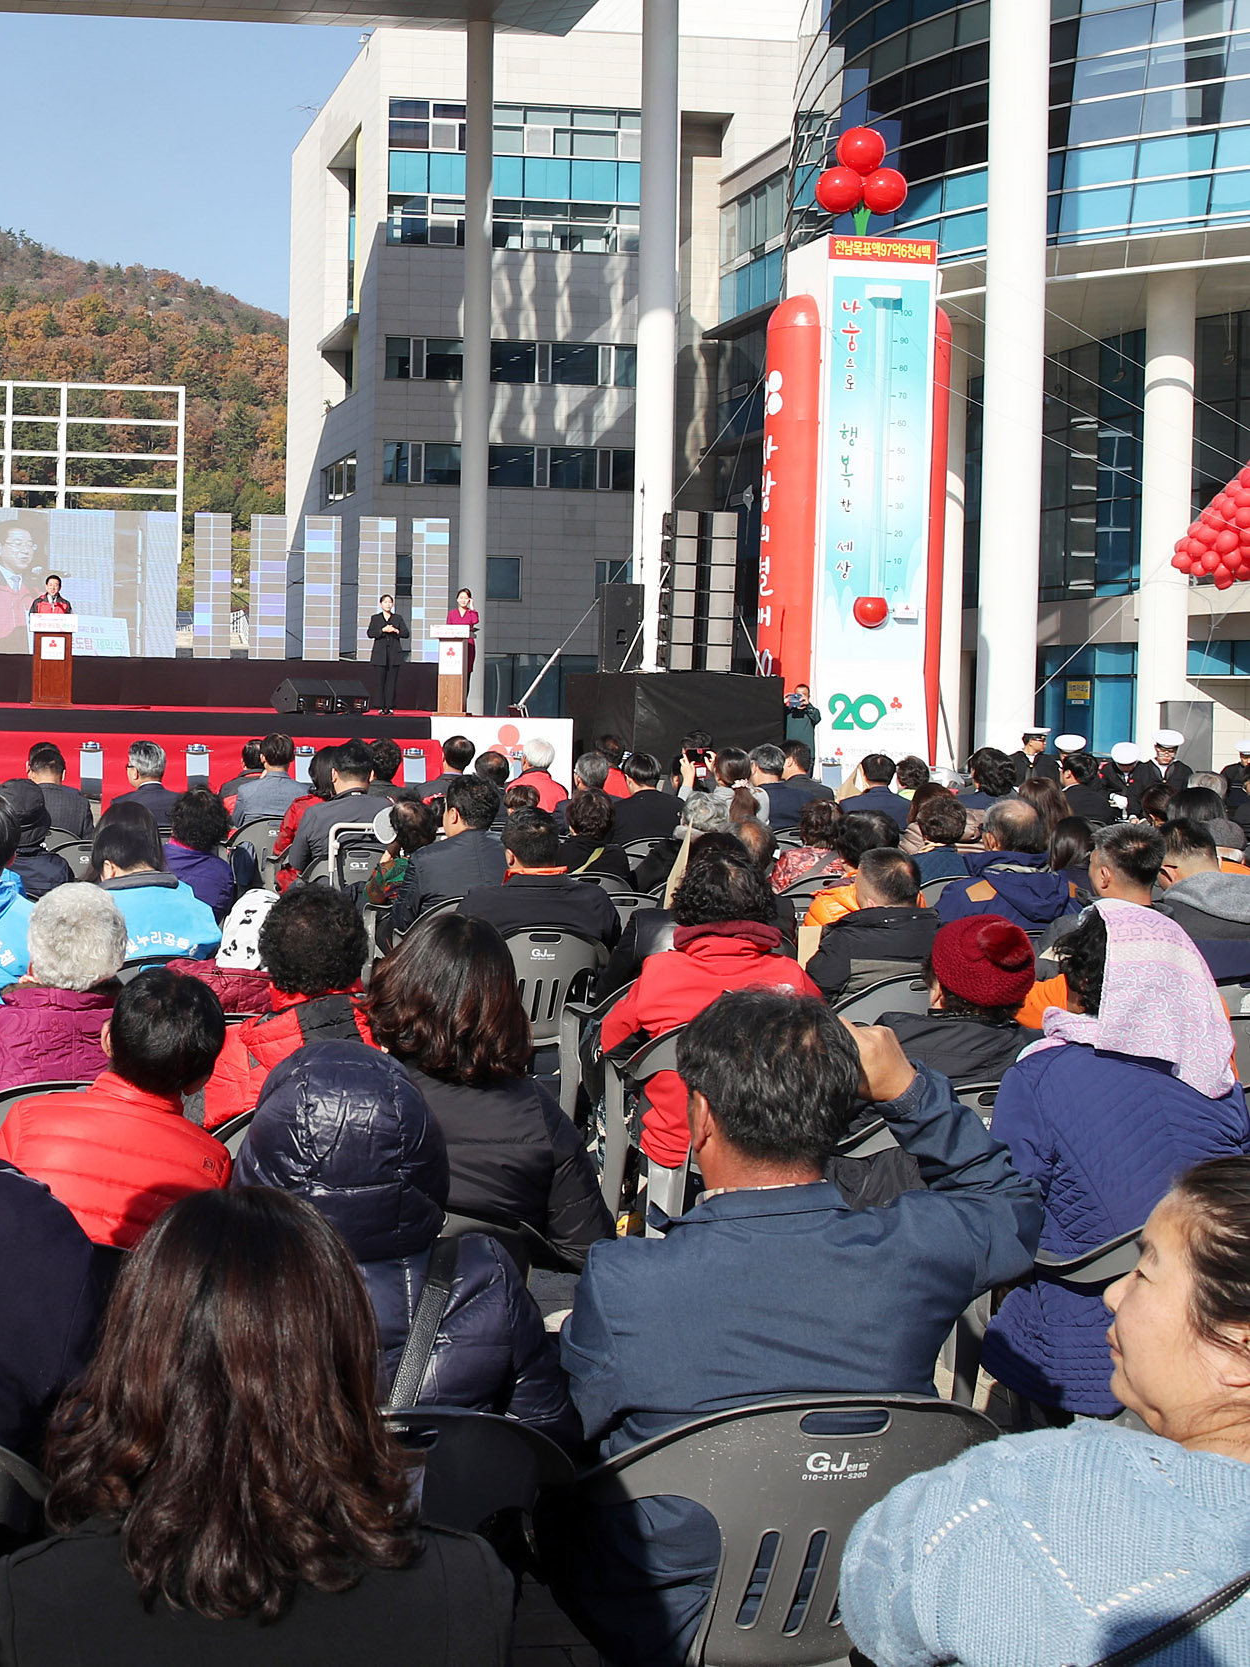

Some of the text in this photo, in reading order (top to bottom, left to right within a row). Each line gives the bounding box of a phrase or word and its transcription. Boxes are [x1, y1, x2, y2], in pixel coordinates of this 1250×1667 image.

[834, 240, 931, 260] 전남목표액97억6천4백
[900, 309, 913, 317] 100
[899, 337, 909, 345] 90
[898, 364, 908, 372] 80
[898, 392, 907, 400] 70
[897, 419, 907, 427] 60
[836, 300, 863, 579] 나눔으로 행복한 세상
[896, 447, 906, 455] 50
[895, 474, 905, 482] 40
[895, 502, 904, 510] 30
[894, 529, 903, 538] 20
[893, 557, 902, 565] 10
[828, 693, 887, 731] 20
[801, 1471, 868, 1481] 010-2111-5200
